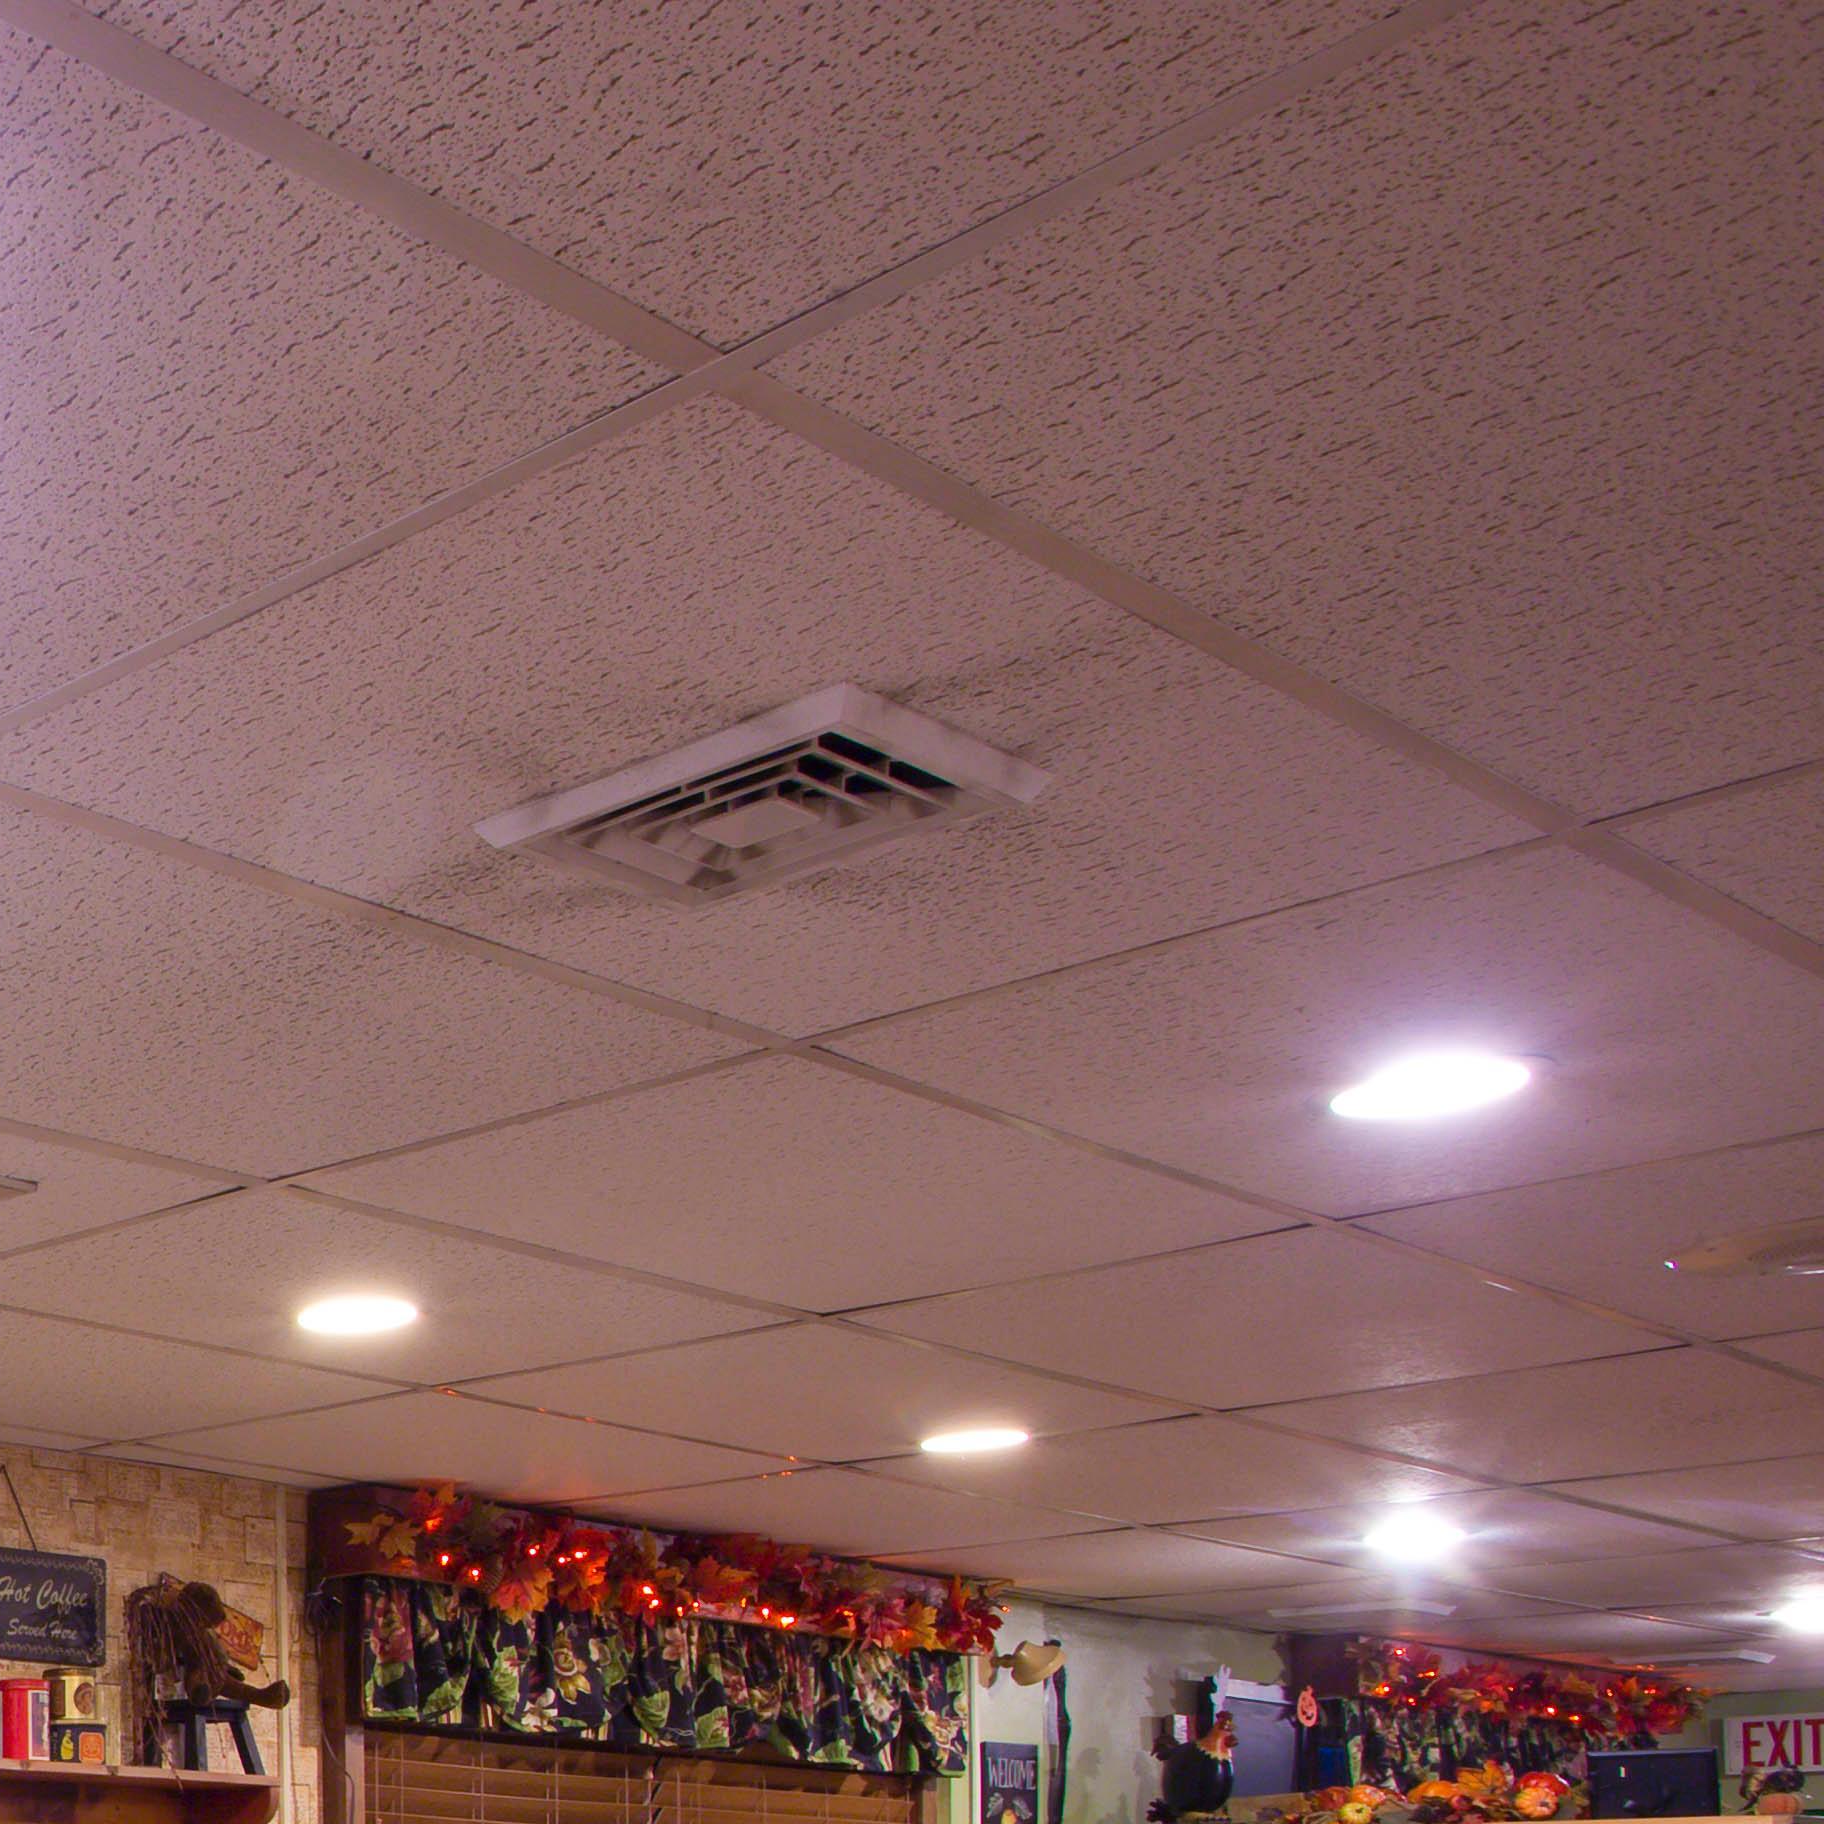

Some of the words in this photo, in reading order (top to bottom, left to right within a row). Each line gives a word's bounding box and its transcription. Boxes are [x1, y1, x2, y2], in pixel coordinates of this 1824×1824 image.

[36, 1578, 89, 1615] Coffee
[6, 1617, 47, 1638] Served
[49, 1620, 79, 1641] Here
[1743, 1718, 1824, 1768] EXIT
[987, 1757, 1037, 1790] WELCOME
